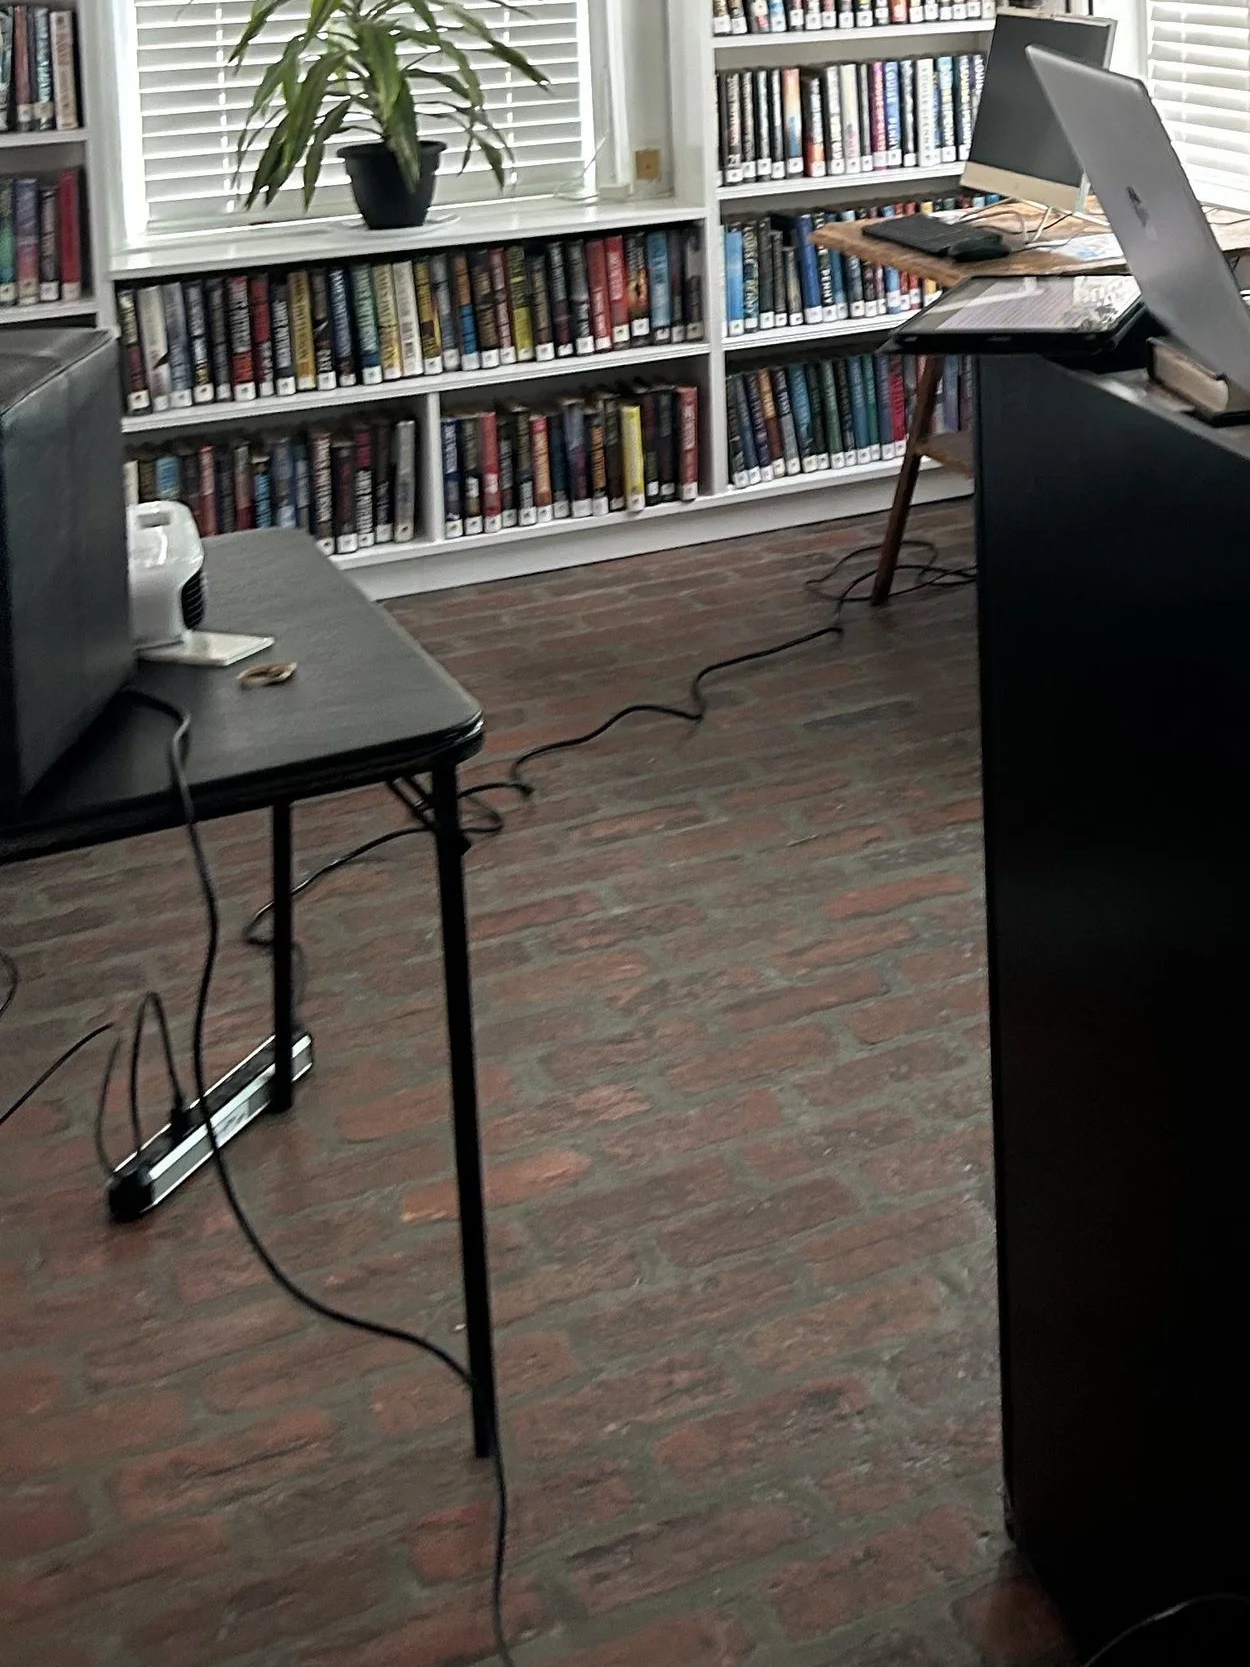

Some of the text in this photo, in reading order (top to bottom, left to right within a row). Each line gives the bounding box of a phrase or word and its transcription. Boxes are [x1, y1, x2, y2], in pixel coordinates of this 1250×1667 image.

[885, 65, 899, 149] LOUISE PENNY
[821, 269, 832, 305] PENNY
[313, 439, 332, 522] JAMES PATTERSON
